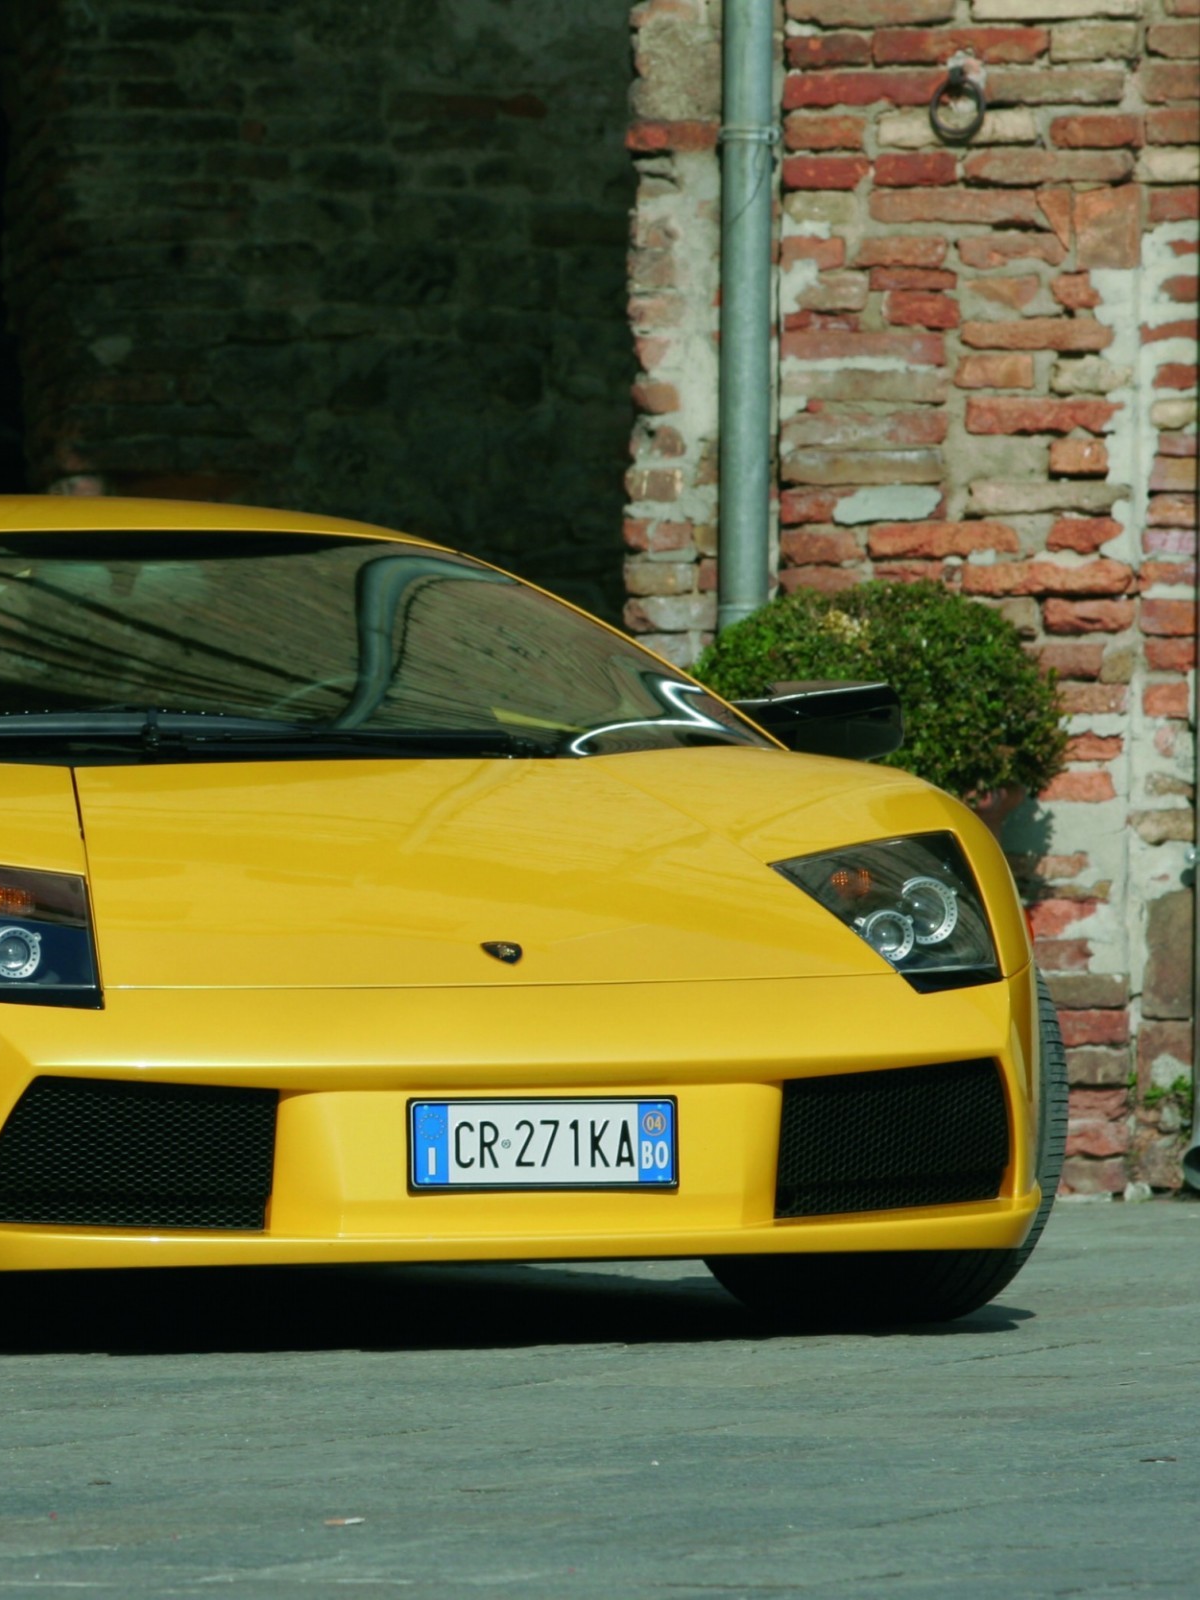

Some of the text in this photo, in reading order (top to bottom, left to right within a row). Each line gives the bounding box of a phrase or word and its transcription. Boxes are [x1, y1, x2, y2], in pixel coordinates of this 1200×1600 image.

[646, 1117, 663, 1130] 04
[454, 1119, 636, 1169] CR 271KA
[641, 1141, 669, 1170] BO
[427, 1147, 437, 1176] I
